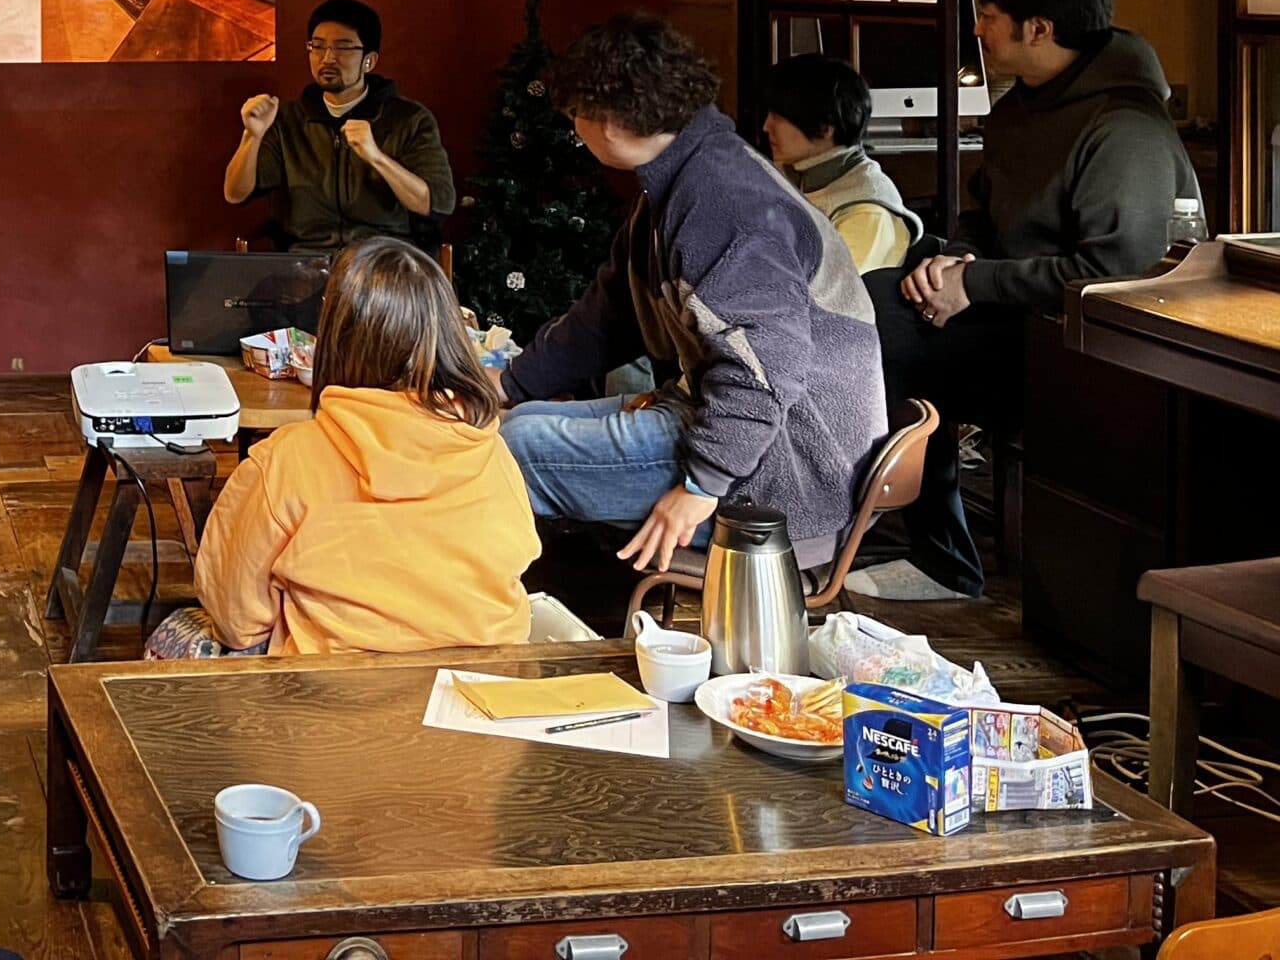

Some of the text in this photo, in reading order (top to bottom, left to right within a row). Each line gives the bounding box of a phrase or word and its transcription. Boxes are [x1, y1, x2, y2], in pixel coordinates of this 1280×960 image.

[872, 764, 911, 785] ひとときの
